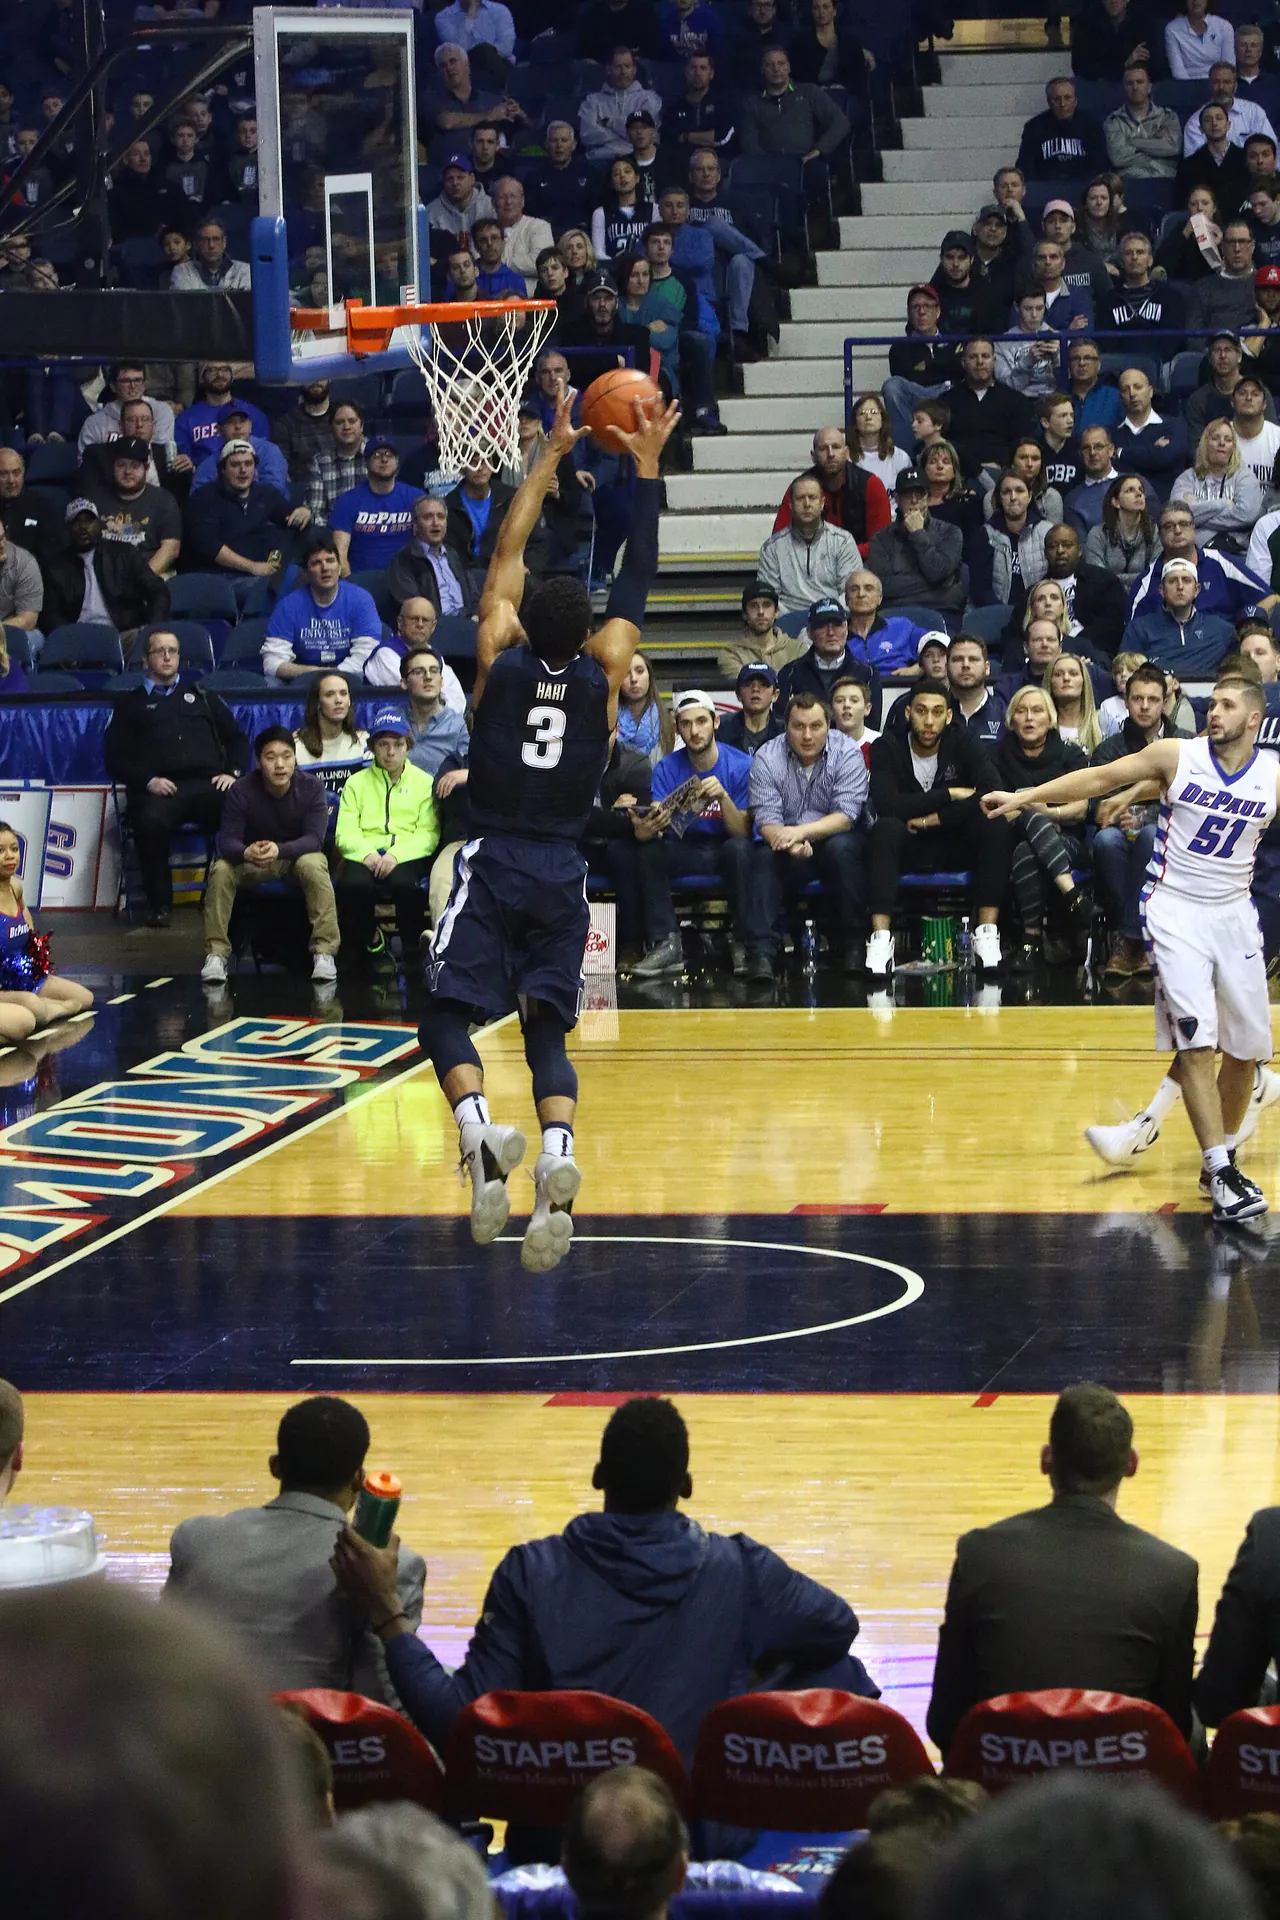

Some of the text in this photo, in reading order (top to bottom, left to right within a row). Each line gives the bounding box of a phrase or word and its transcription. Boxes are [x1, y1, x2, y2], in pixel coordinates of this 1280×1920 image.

[1045, 462, 1077, 484] CBP
[536, 681, 568, 701] HART
[521, 705, 567, 769] 3
[316, 769, 352, 781] VILLANOVA
[1187, 815, 1248, 859] 51
[586, 931, 601, 942] OP
[0, 1015, 421, 1277] MONS
[474, 1735, 636, 1768] STAPLES
[724, 1733, 887, 1771] STAPLES
[980, 1731, 1147, 1766] STAPLES
